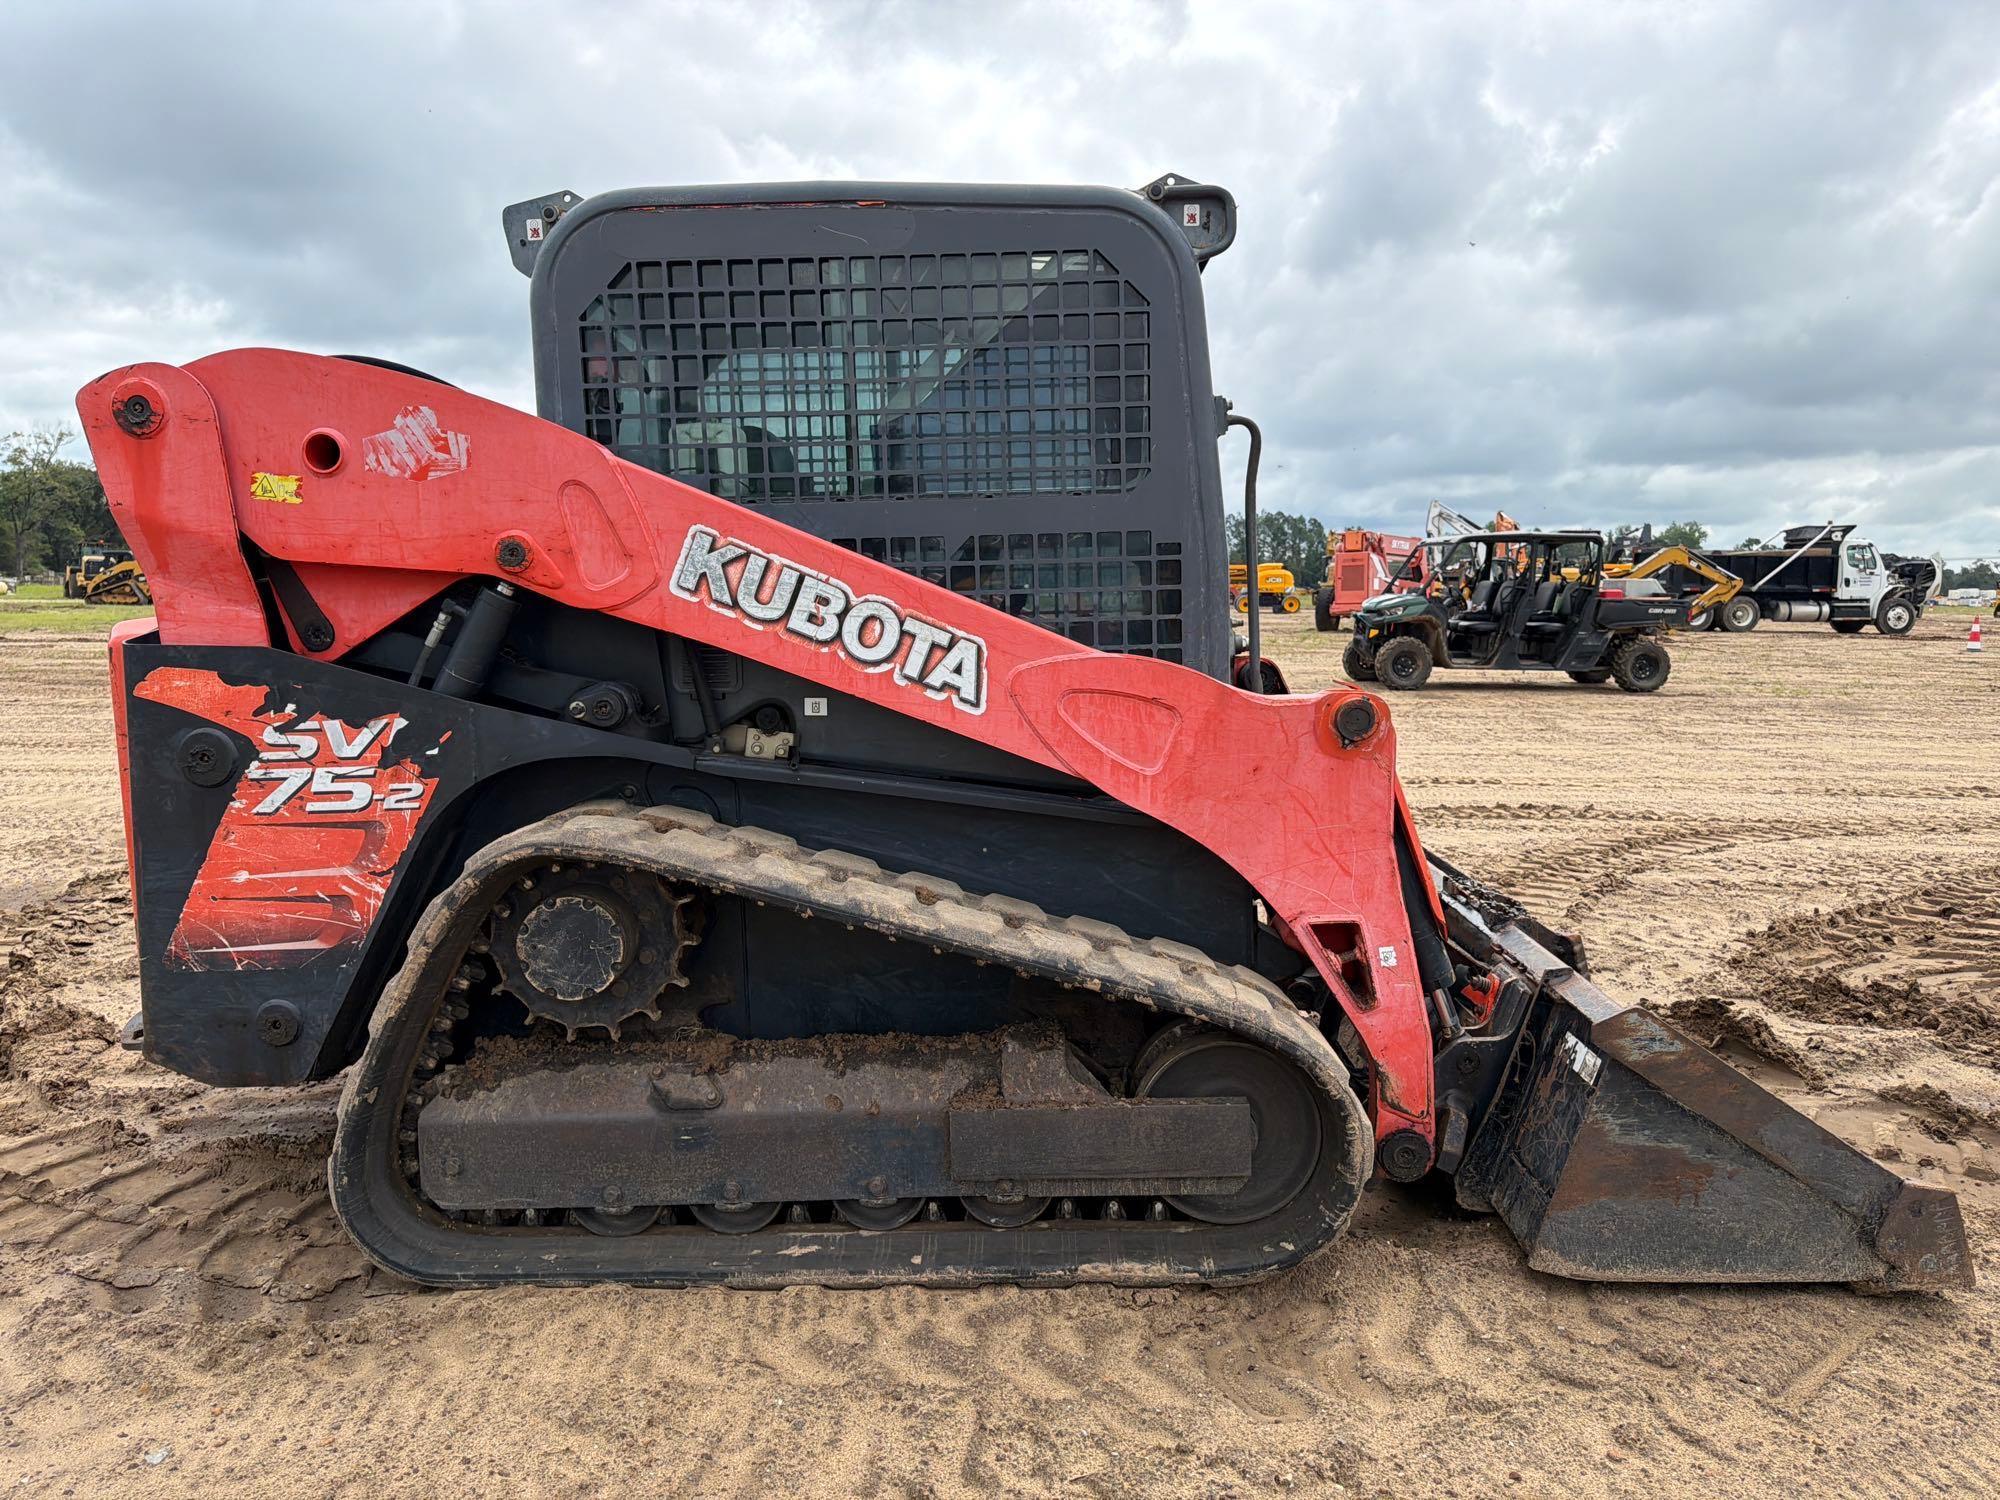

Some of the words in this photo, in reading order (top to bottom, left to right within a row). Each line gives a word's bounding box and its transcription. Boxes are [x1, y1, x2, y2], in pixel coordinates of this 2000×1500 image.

[675, 529, 982, 708] KUBOTA
[257, 717, 393, 763] SV
[246, 765, 425, 815] 75-2
